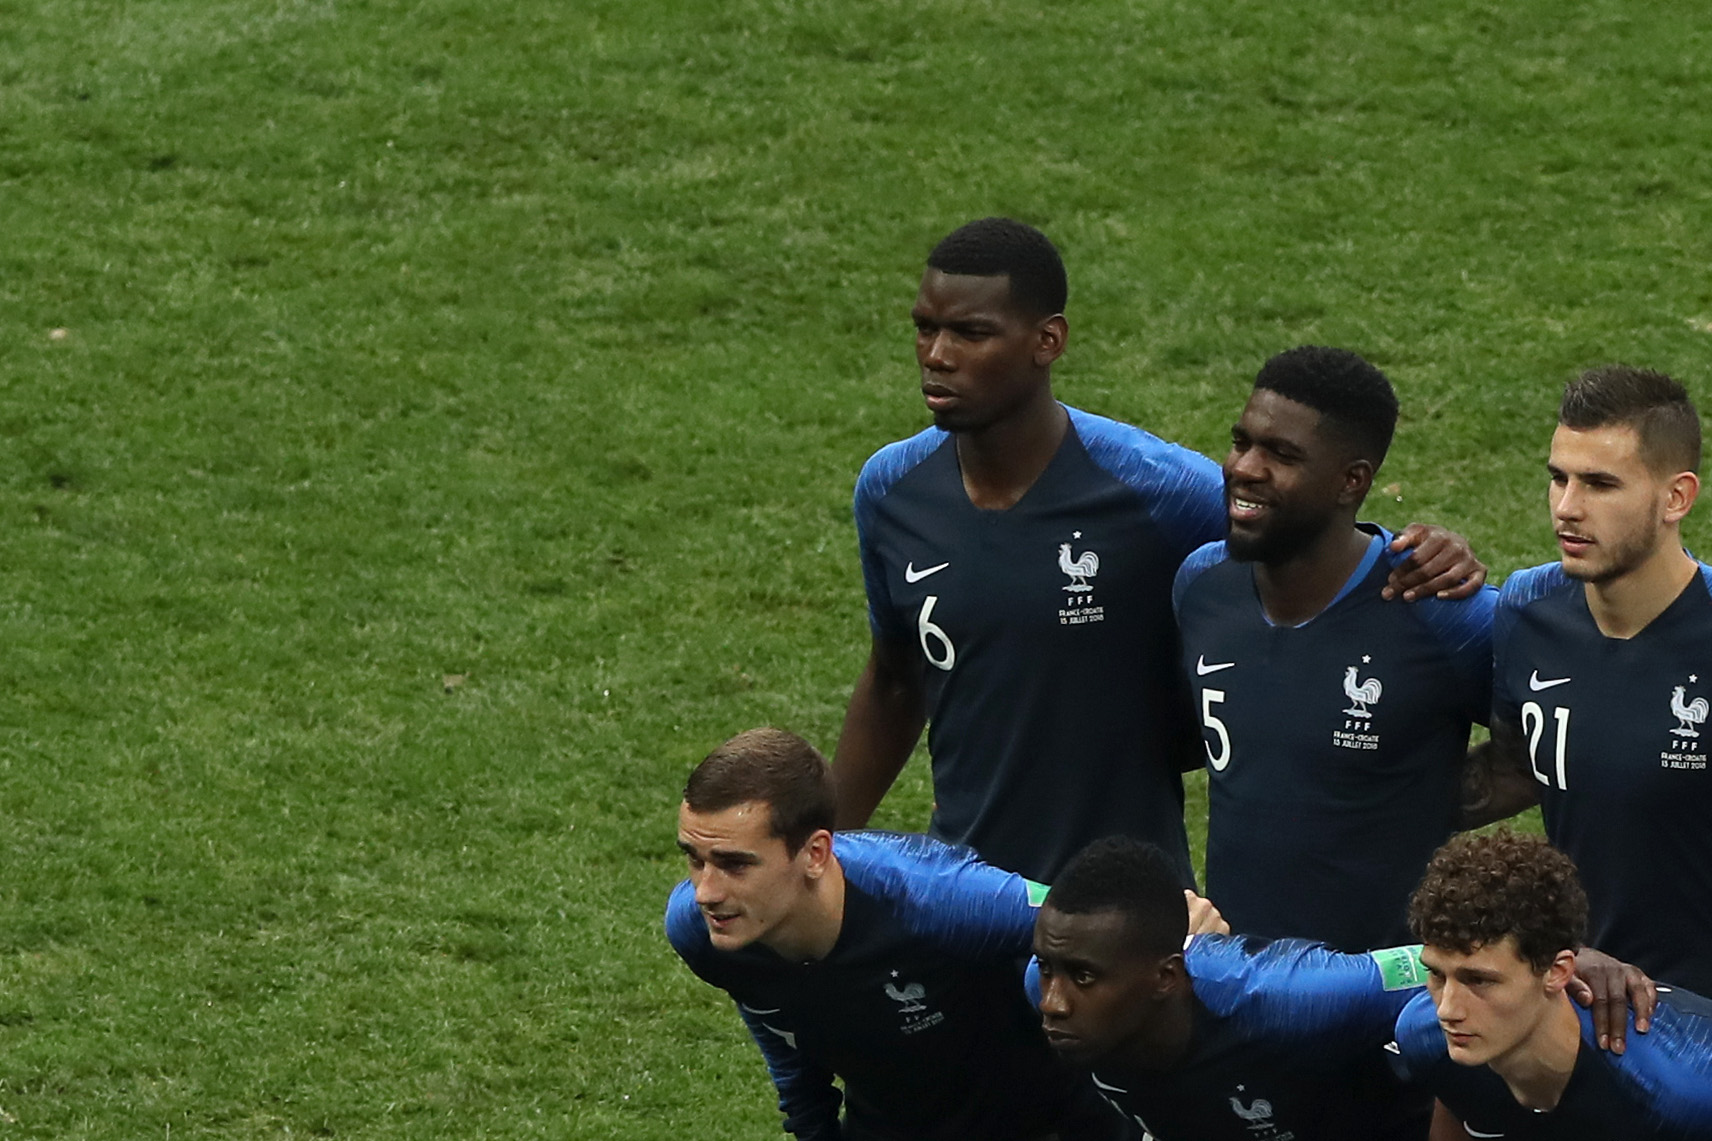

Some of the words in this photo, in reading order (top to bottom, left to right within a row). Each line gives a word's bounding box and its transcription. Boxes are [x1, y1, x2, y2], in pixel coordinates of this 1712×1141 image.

[918, 595, 956, 671] 6
[1202, 688, 1231, 771] 5
[1521, 701, 1570, 791] 21
